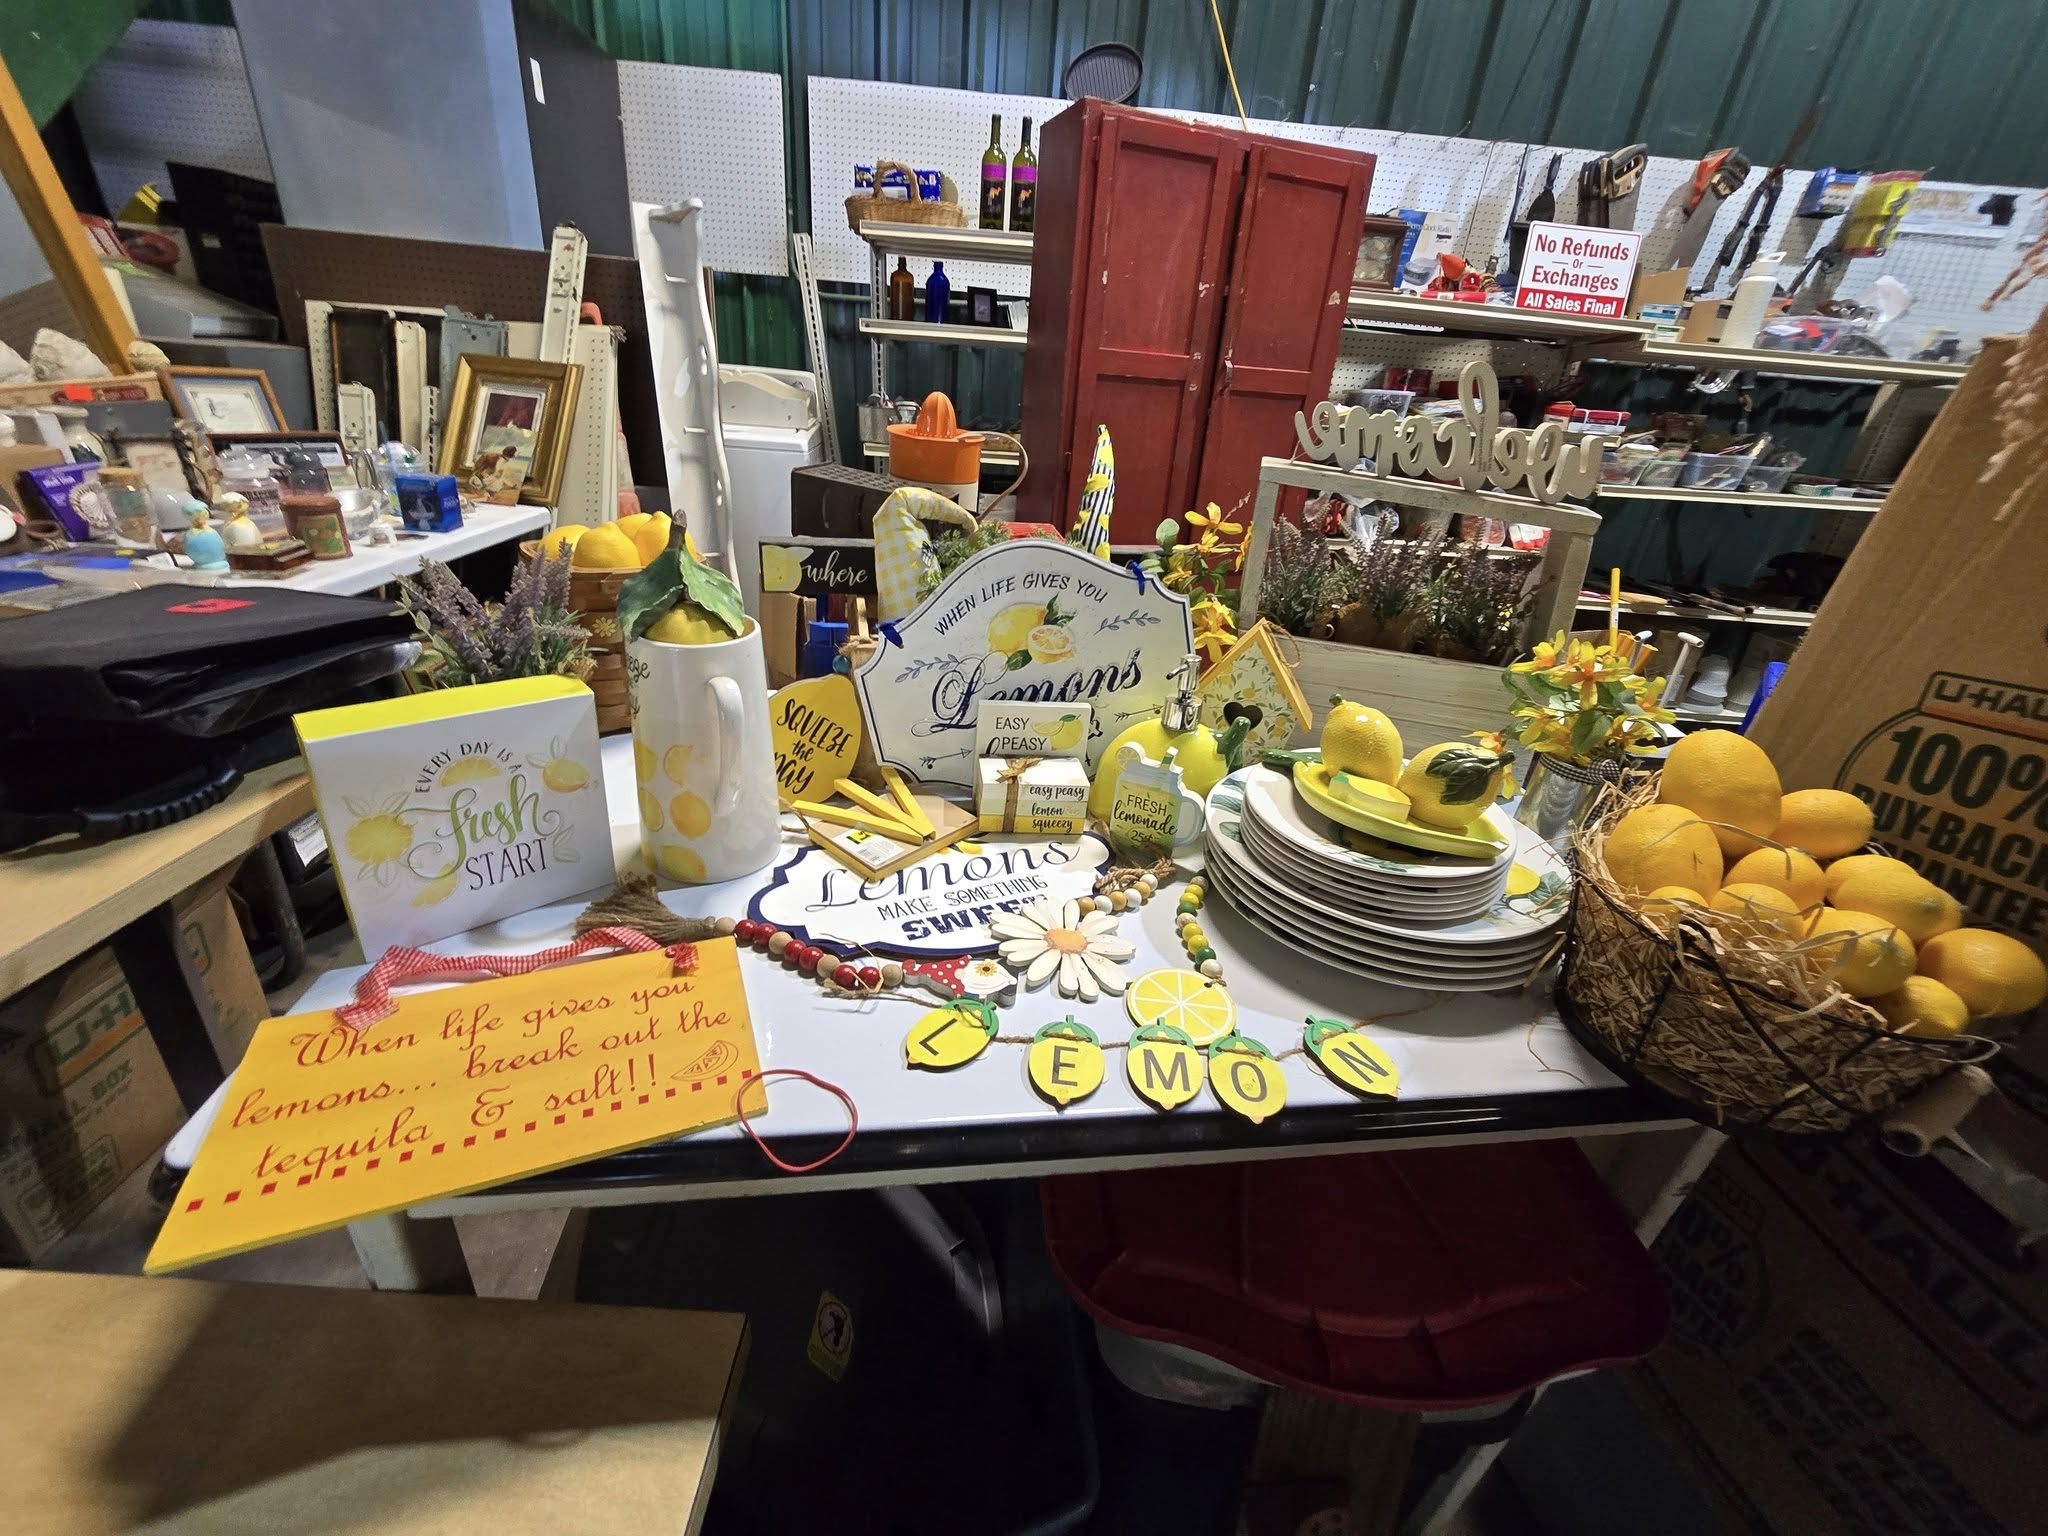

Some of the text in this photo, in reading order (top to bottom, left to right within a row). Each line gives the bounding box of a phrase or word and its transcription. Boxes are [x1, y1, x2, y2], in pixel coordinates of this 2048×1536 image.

[1535, 233, 1630, 261] No Refunds
[1572, 257, 1584, 270] Or
[1531, 265, 1620, 293] Exchanges
[1523, 292, 1617, 316] All Sales Final
[801, 550, 868, 587] where
[933, 572, 1109, 636] WHEN LIFE GIVES YOU
[776, 698, 853, 758] SQUEEZE
[995, 716, 1030, 731] EASY
[792, 740, 815, 762] the
[1001, 737, 1048, 751] PEASY
[415, 741, 523, 794] EVERY DAY IS A
[1883, 725, 2048, 834] 100%
[1029, 786, 1085, 801] easy peasy
[1031, 802, 1065, 816] lemon
[1127, 794, 1168, 817] FRESH
[393, 773, 562, 880] fresh
[1032, 819, 1073, 833] squeezy
[1113, 799, 1178, 836] lemonade
[465, 837, 548, 891] START
[805, 840, 1081, 912] Lemons
[877, 875, 1048, 921] MAKE SOMETHING
[900, 893, 1048, 941] SWEE
[290, 980, 696, 1067] When life gives you
[463, 1027, 584, 1079] break
[600, 1023, 661, 1051] out
[676, 1000, 731, 1033] the
[250, 1107, 434, 1181] tequila
[469, 1087, 515, 1127] &
